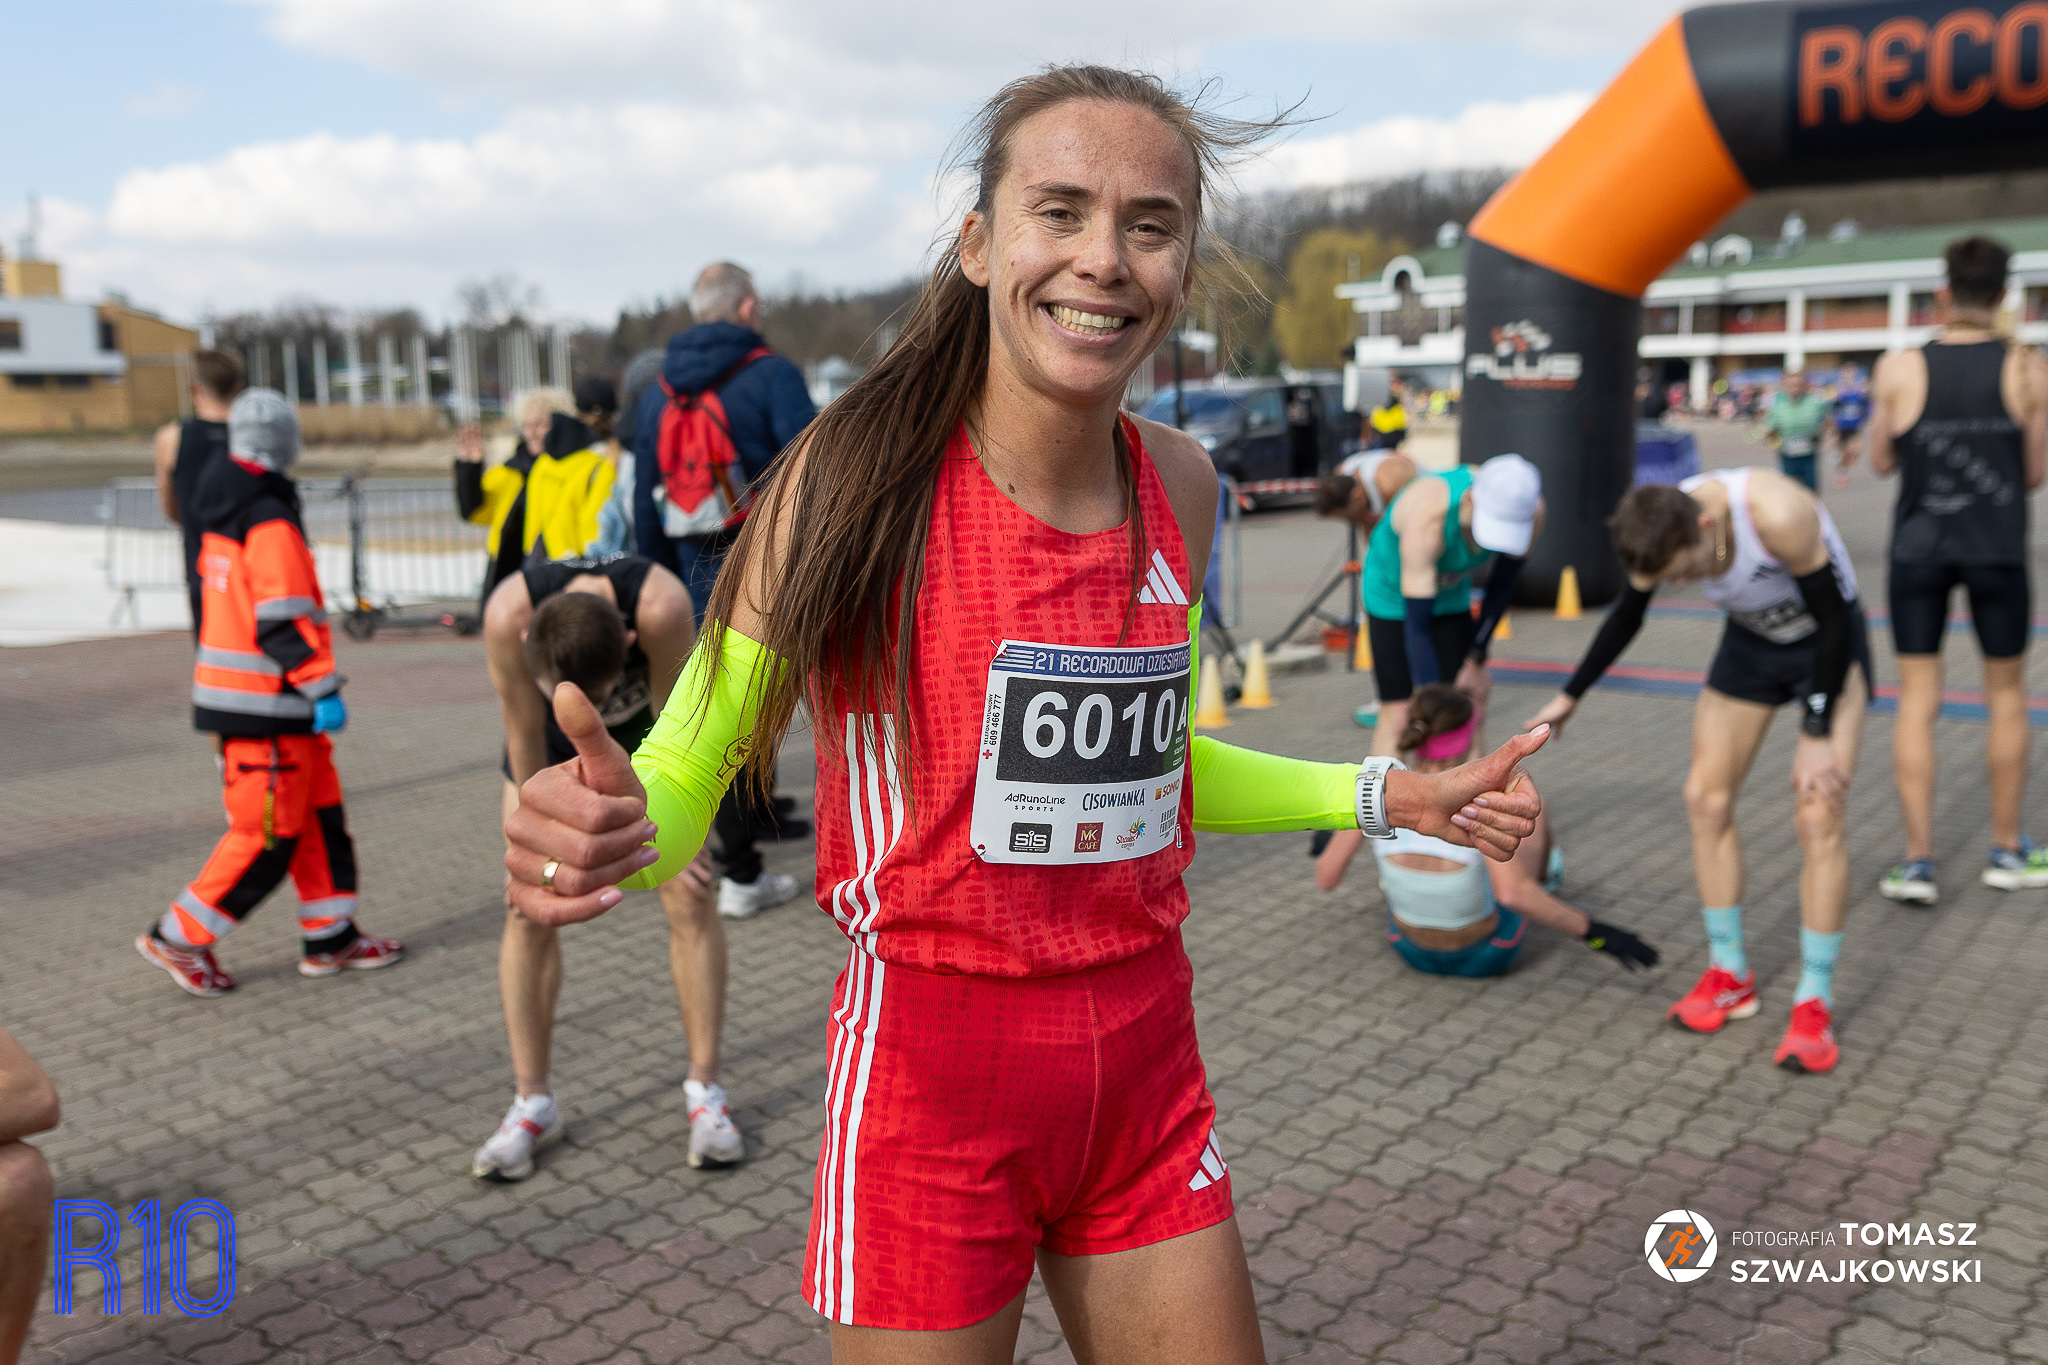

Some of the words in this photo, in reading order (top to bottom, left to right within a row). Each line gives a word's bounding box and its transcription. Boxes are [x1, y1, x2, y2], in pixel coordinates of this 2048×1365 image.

[1035, 653, 1055, 671] 21
[1059, 653, 1145, 674] RECORDOWA
[993, 694, 1002, 710] 777
[991, 712, 1001, 728] 466
[1176, 696, 1187, 731] A
[1022, 688, 1176, 760] 6010
[989, 730, 998, 746] 609
[1082, 788, 1145, 811] CISOWIANKA
[1080, 829, 1098, 841] MK
